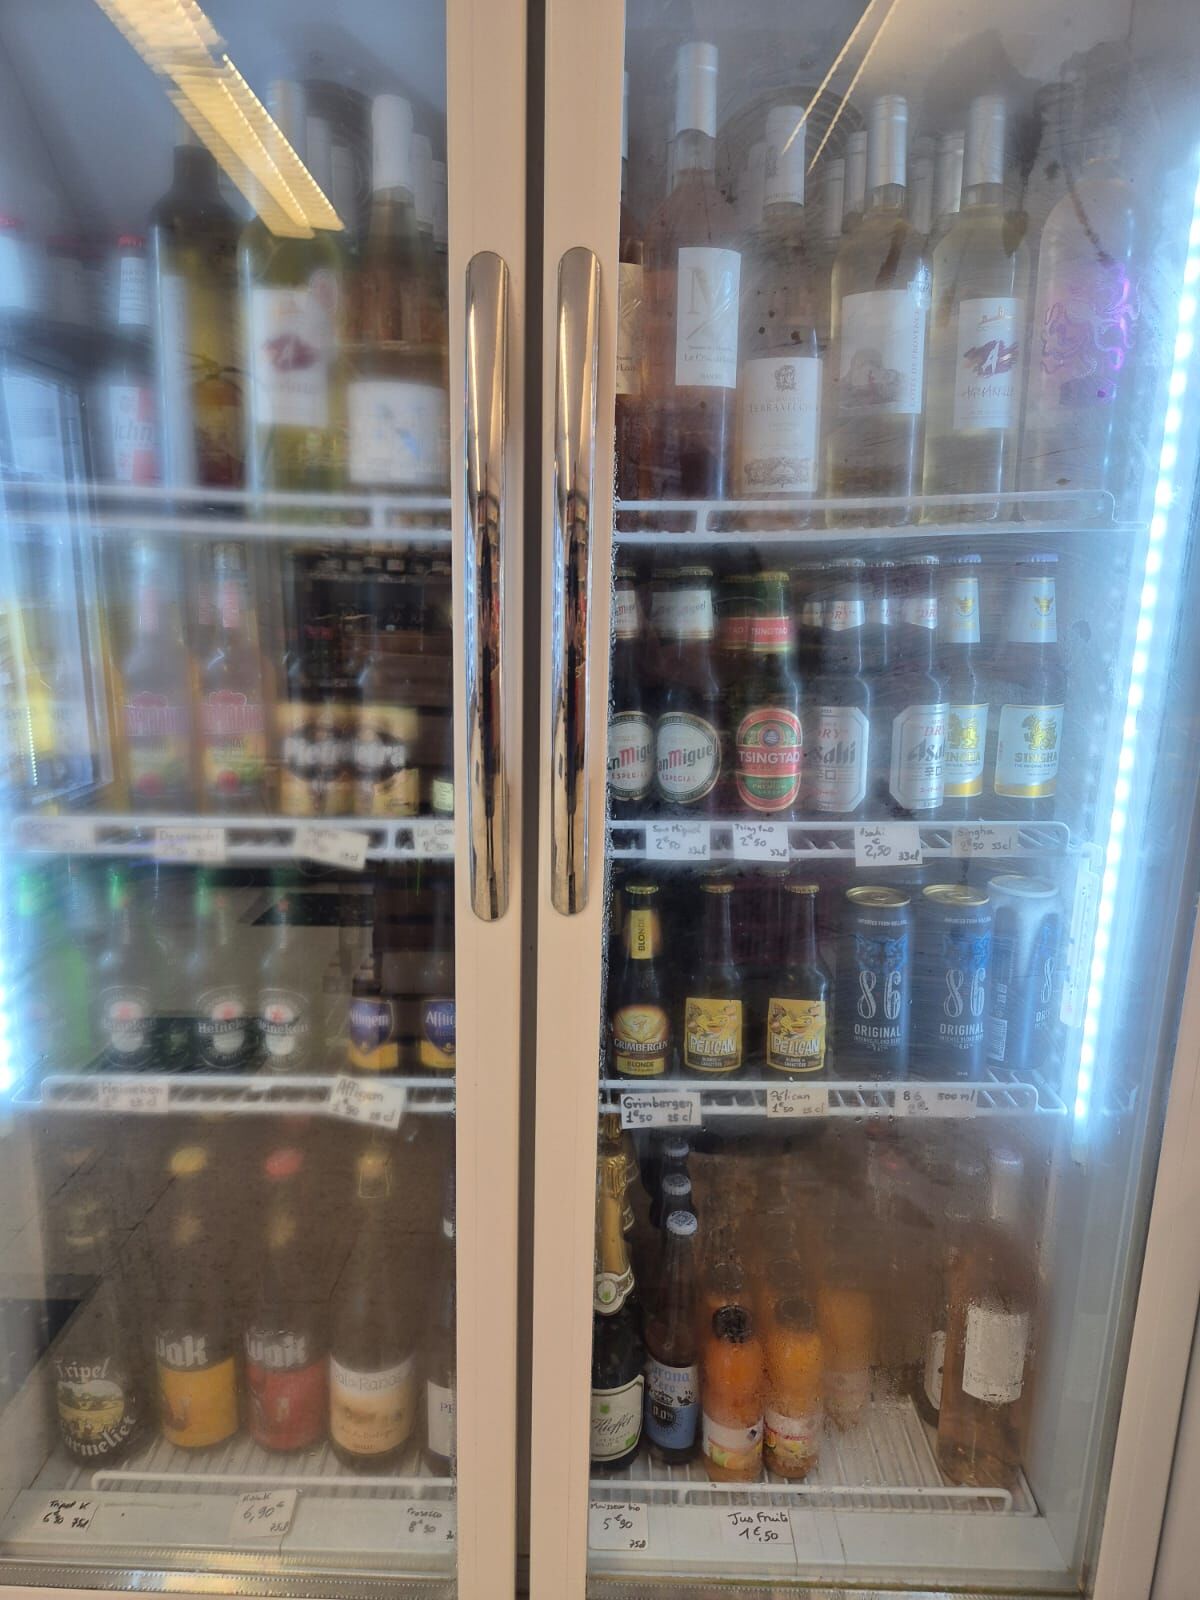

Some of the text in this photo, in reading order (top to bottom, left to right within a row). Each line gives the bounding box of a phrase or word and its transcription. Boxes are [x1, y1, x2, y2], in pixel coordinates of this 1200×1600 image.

[738, 750, 801, 764] TSINGTAO
[1014, 751, 1058, 763] SINGHA
[898, 849, 920, 862] 33cl
[854, 1023, 901, 1037] ORIGINAL
[939, 1022, 984, 1036] ORIGINAL
[614, 1038, 668, 1051] GRIMBERGEN
[623, 1095, 693, 1111] Grimbergen
[626, 1110, 653, 1123] 1€50
[728, 1511, 789, 1525] Jus Fruits
